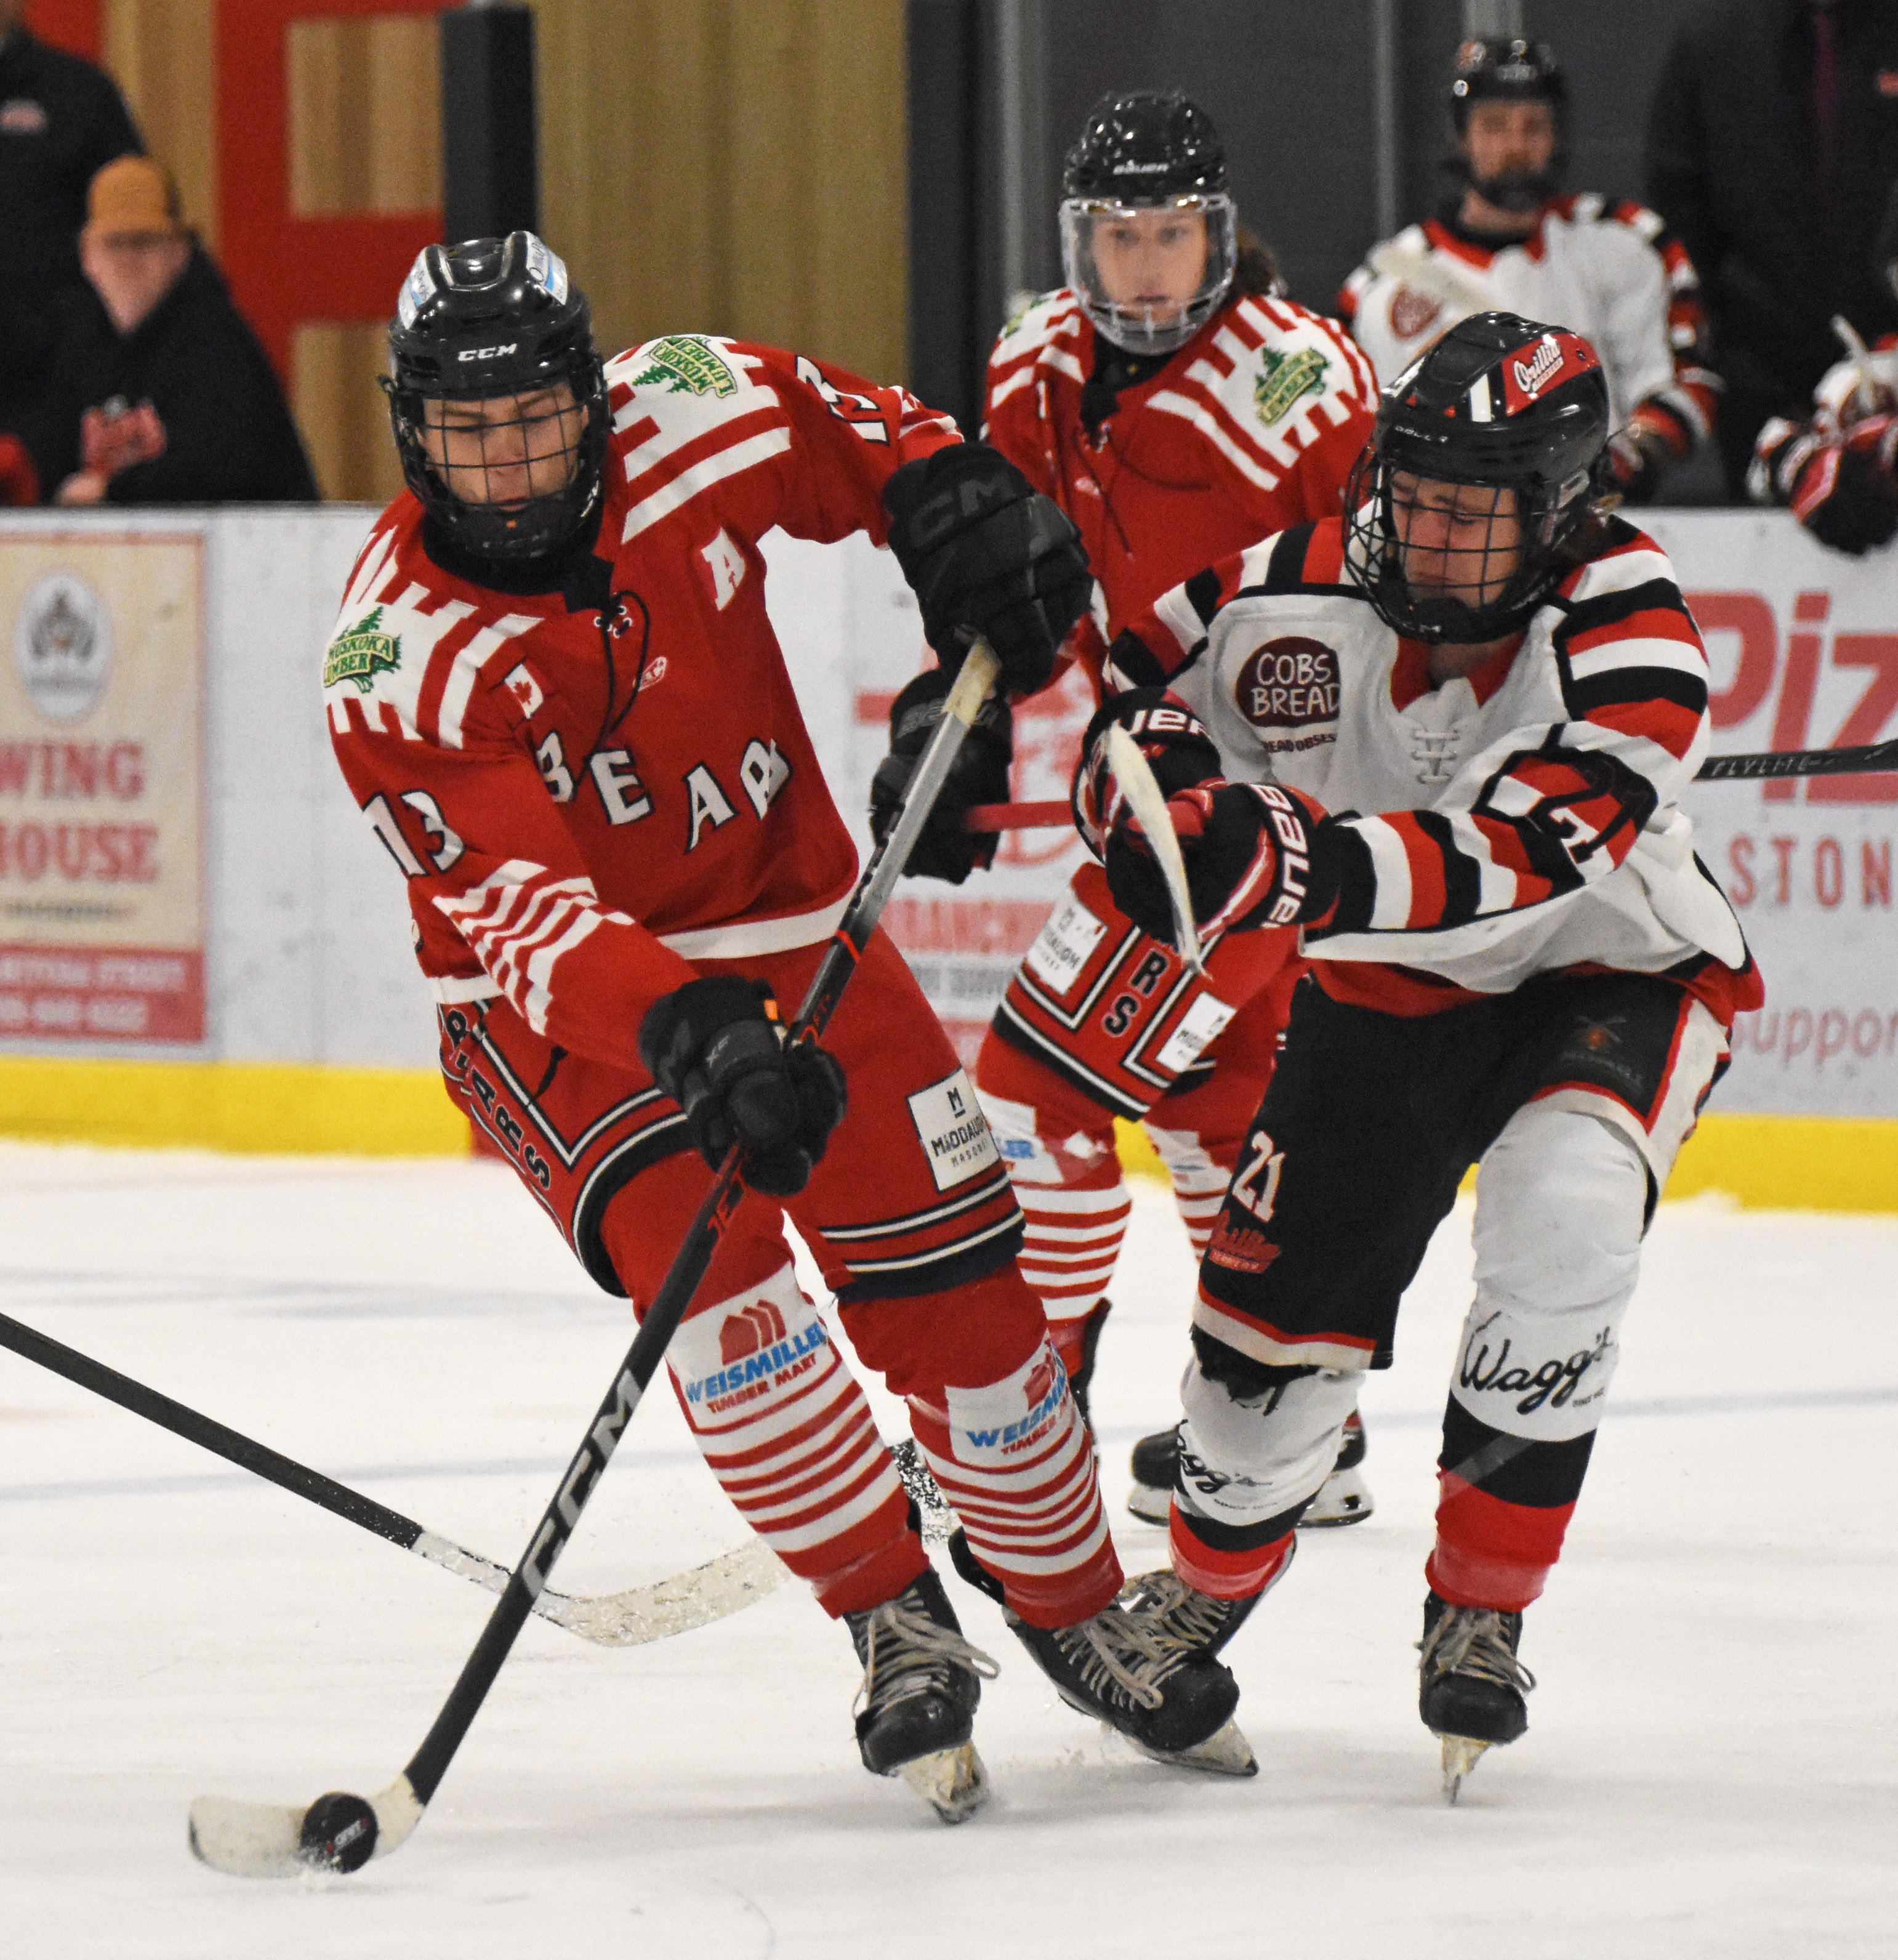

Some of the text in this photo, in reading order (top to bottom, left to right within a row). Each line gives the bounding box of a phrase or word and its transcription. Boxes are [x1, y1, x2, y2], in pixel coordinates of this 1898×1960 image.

[457, 342, 517, 362] CCM
[701, 526, 746, 611] A
[1251, 683, 1341, 716] BREAD
[1257, 653, 1332, 685] COBS
[1295, 733, 1337, 752] OBSES
[0, 820, 159, 883] OUSE
[362, 788, 467, 877] 13
[946, 1086, 964, 1112] M
[1232, 1130, 1286, 1223] 21
[706, 1352, 816, 1414] TIMBER MART
[522, 1368, 644, 1599] CCM
